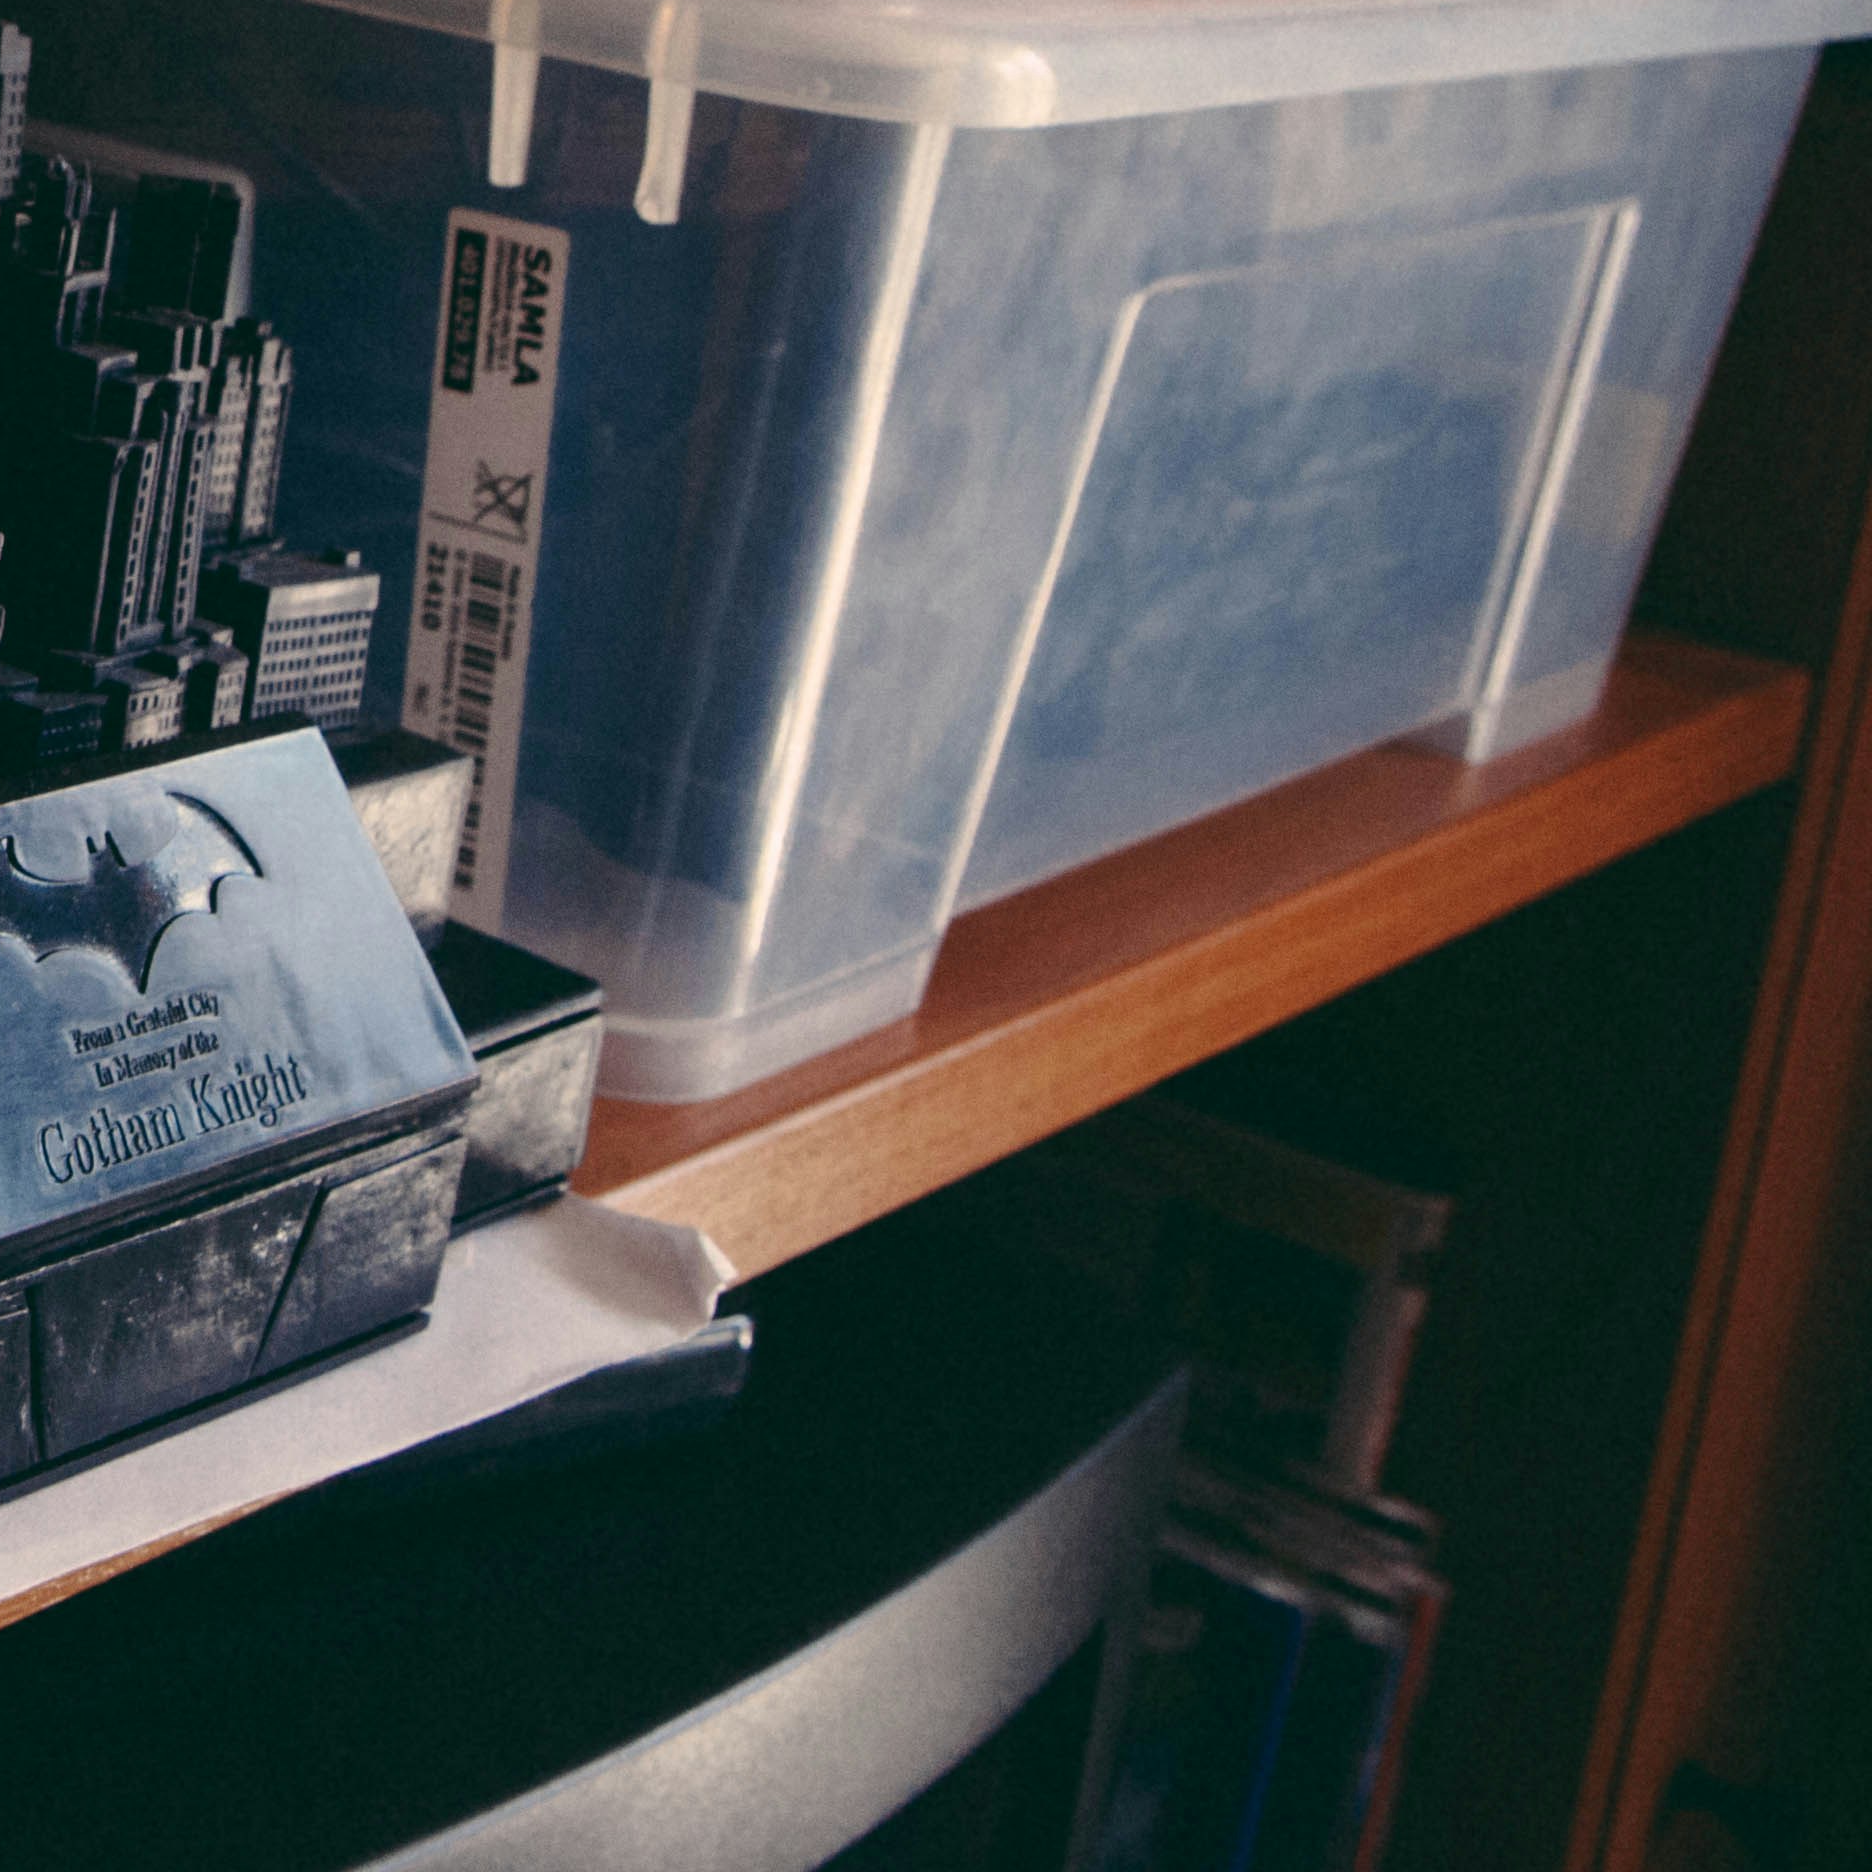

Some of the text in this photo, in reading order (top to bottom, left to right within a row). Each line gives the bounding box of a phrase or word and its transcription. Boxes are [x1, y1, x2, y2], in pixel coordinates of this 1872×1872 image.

[513, 246, 551, 385] SAMLA
[69, 1026, 115, 1056] From
[39, 1052, 307, 1185] Gotham Knight
